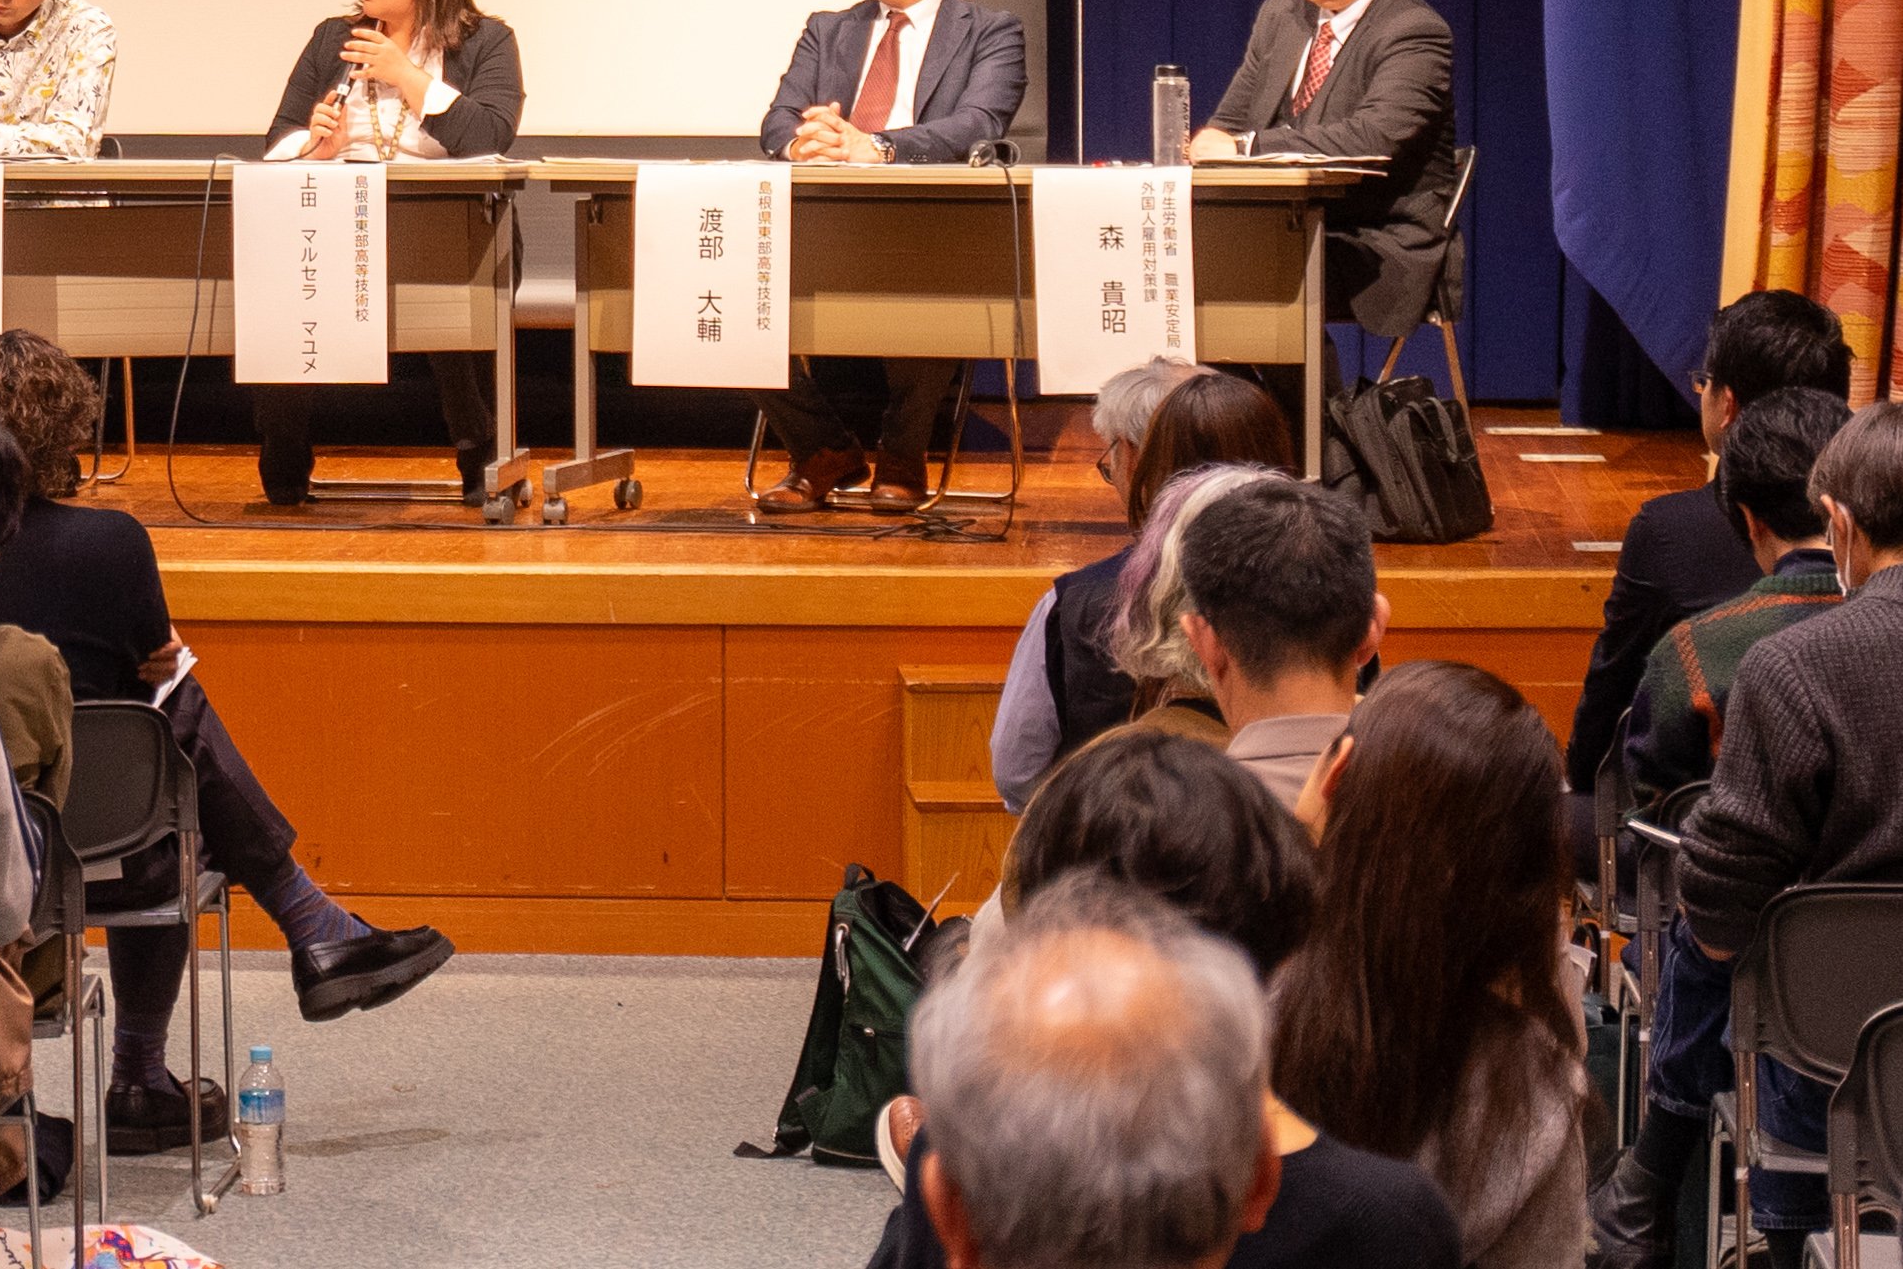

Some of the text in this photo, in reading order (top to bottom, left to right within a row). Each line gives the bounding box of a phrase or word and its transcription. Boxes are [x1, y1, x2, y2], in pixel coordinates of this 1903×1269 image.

[300, 173, 318, 374] 上田 マルセラ マユメ
[354, 175, 369, 322] 島根県東部高等技術校
[697, 207, 724, 343] 渡部 大輔
[756, 180, 772, 331] 島根県東部高等技術校
[1099, 224, 1126, 334] 森 貴昭
